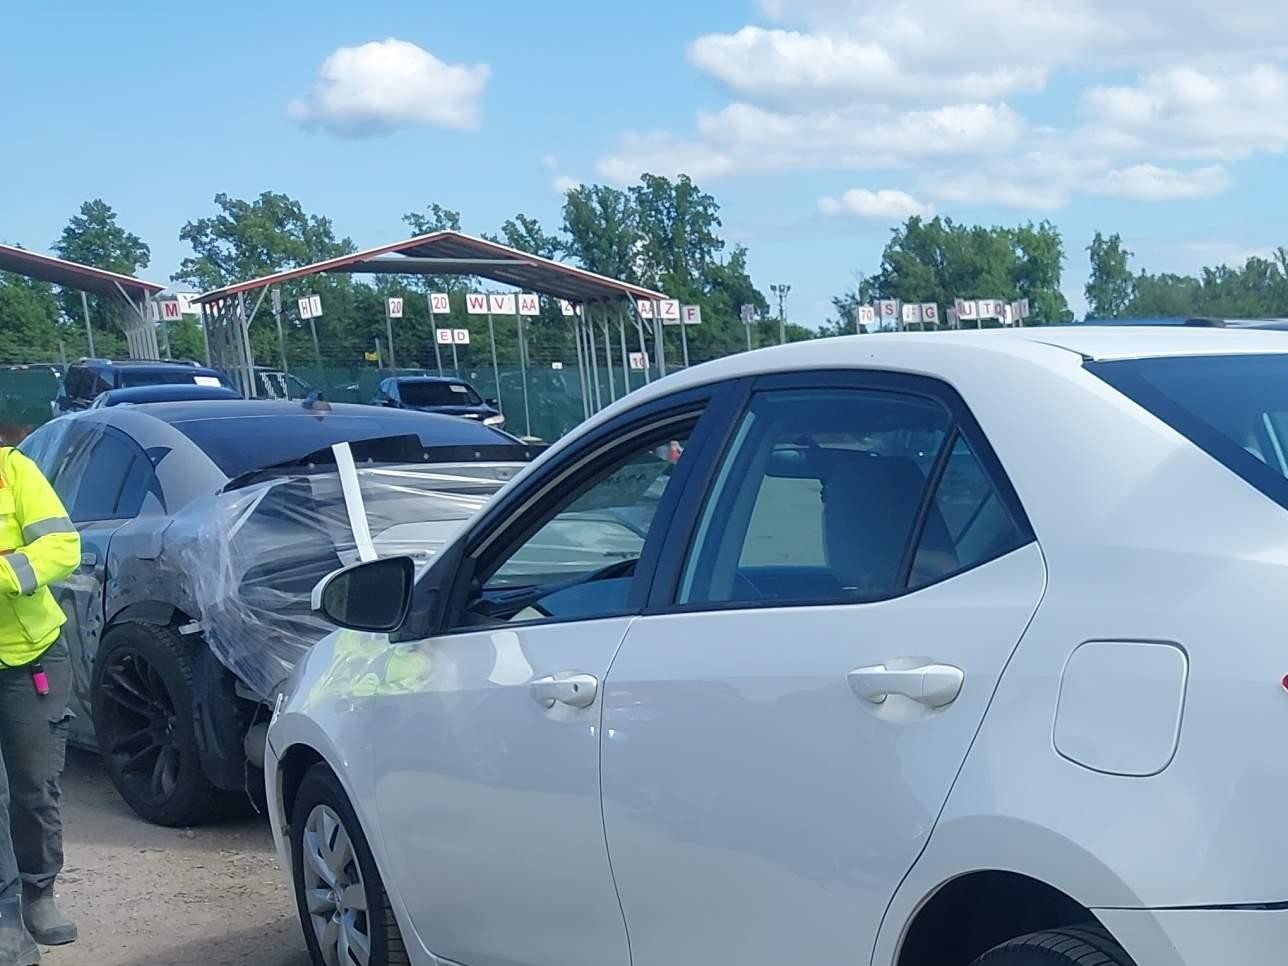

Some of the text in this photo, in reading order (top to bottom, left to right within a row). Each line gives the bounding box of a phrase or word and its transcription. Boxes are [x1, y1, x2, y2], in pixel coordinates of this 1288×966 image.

[165, 303, 178, 316] M
[391, 300, 401, 314] 20
[434, 296, 447, 310] 20
[469, 297, 484, 310] W
[494, 297, 505, 310] V
[521, 299, 537, 312] AA
[665, 302, 675, 315] Z
[885, 303, 894, 316] S
[687, 308, 696, 321] F
[925, 306, 935, 319] G
[440, 331, 449, 341] E
[457, 331, 466, 341] D
